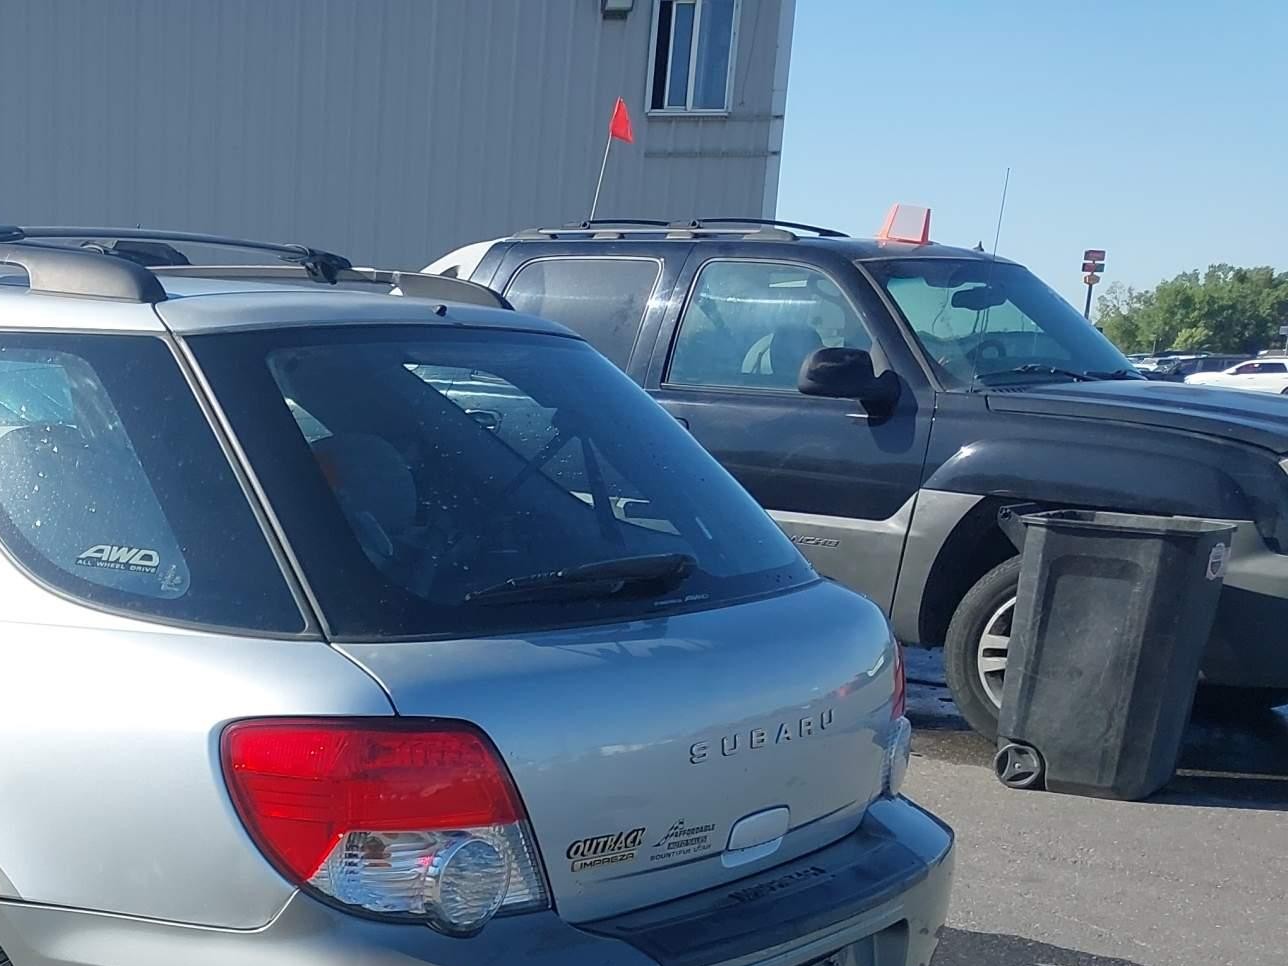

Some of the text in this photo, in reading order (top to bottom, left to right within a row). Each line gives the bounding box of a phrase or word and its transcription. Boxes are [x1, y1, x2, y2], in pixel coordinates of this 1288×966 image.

[76, 544, 160, 567] AWD
[96, 561, 126, 570] WHEEL
[129, 565, 157, 574] DRIVE
[688, 707, 835, 765] SUBARU
[566, 826, 647, 860] OUTBACK
[578, 851, 635, 871] IMPREZA
